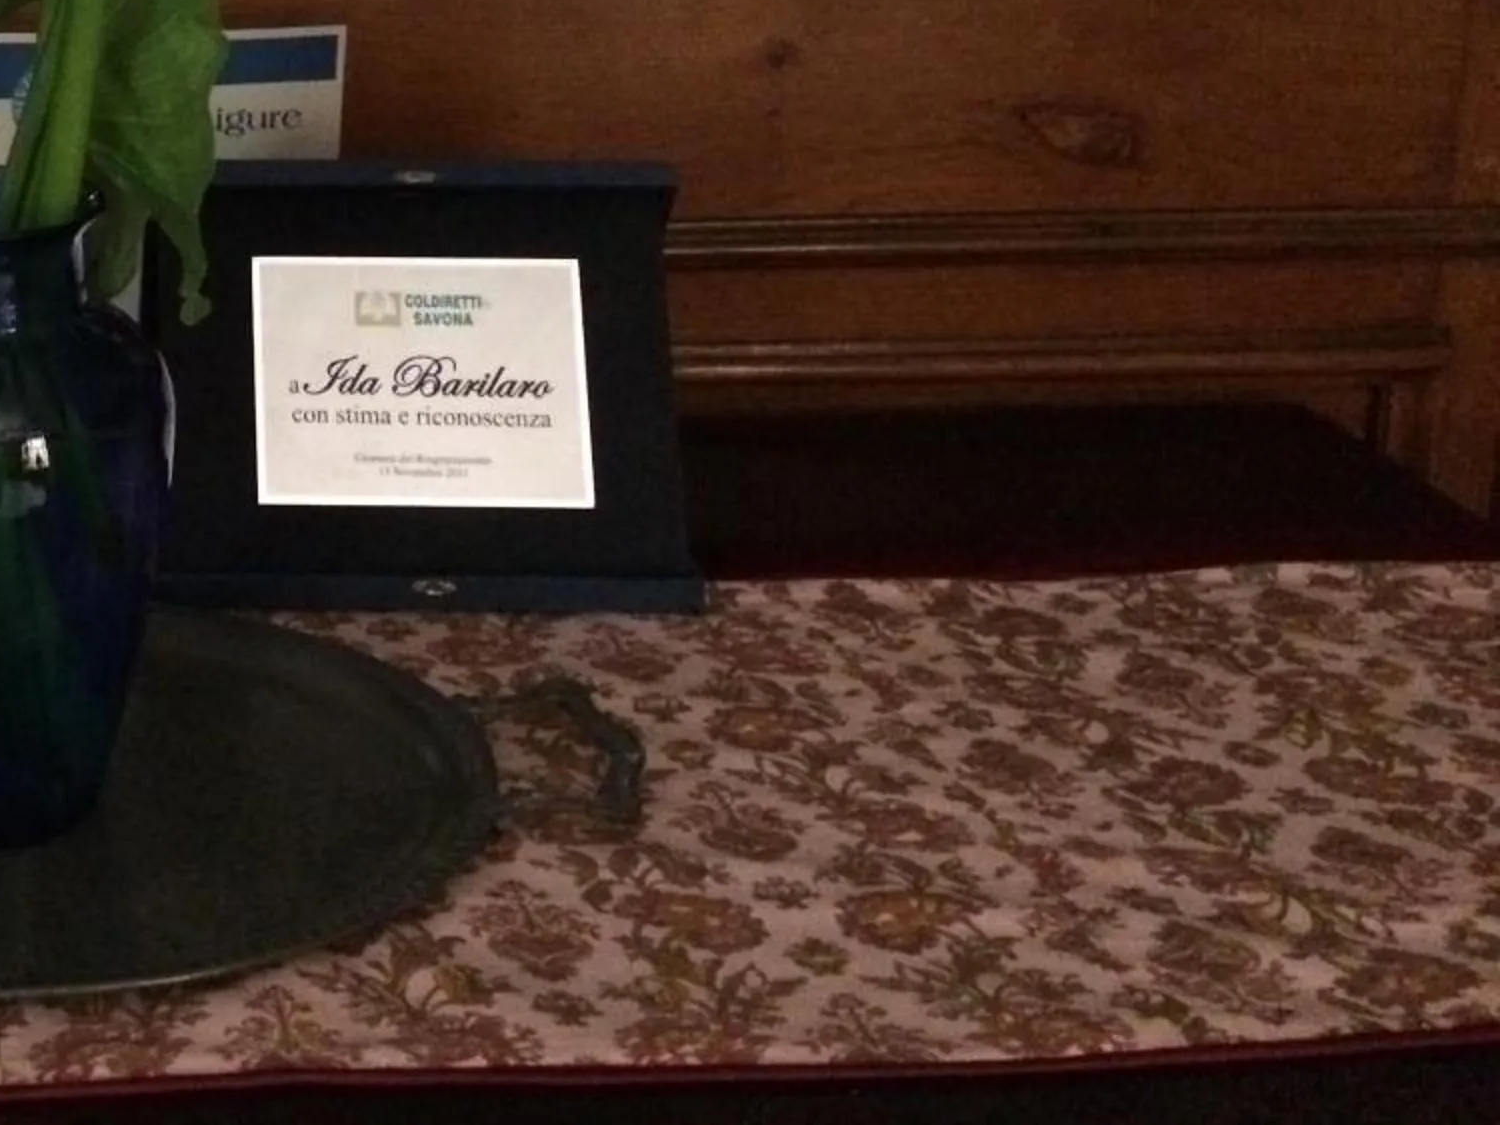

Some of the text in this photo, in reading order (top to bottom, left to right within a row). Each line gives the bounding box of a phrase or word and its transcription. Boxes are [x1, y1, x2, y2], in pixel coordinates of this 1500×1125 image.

[216, 106, 303, 137] igure
[404, 294, 483, 308] COLDIRETTI
[413, 312, 474, 326] SAVONA
[303, 355, 382, 396] Ida
[392, 355, 554, 399] Barilaro
[291, 404, 553, 428] con stima e riconoscenza
